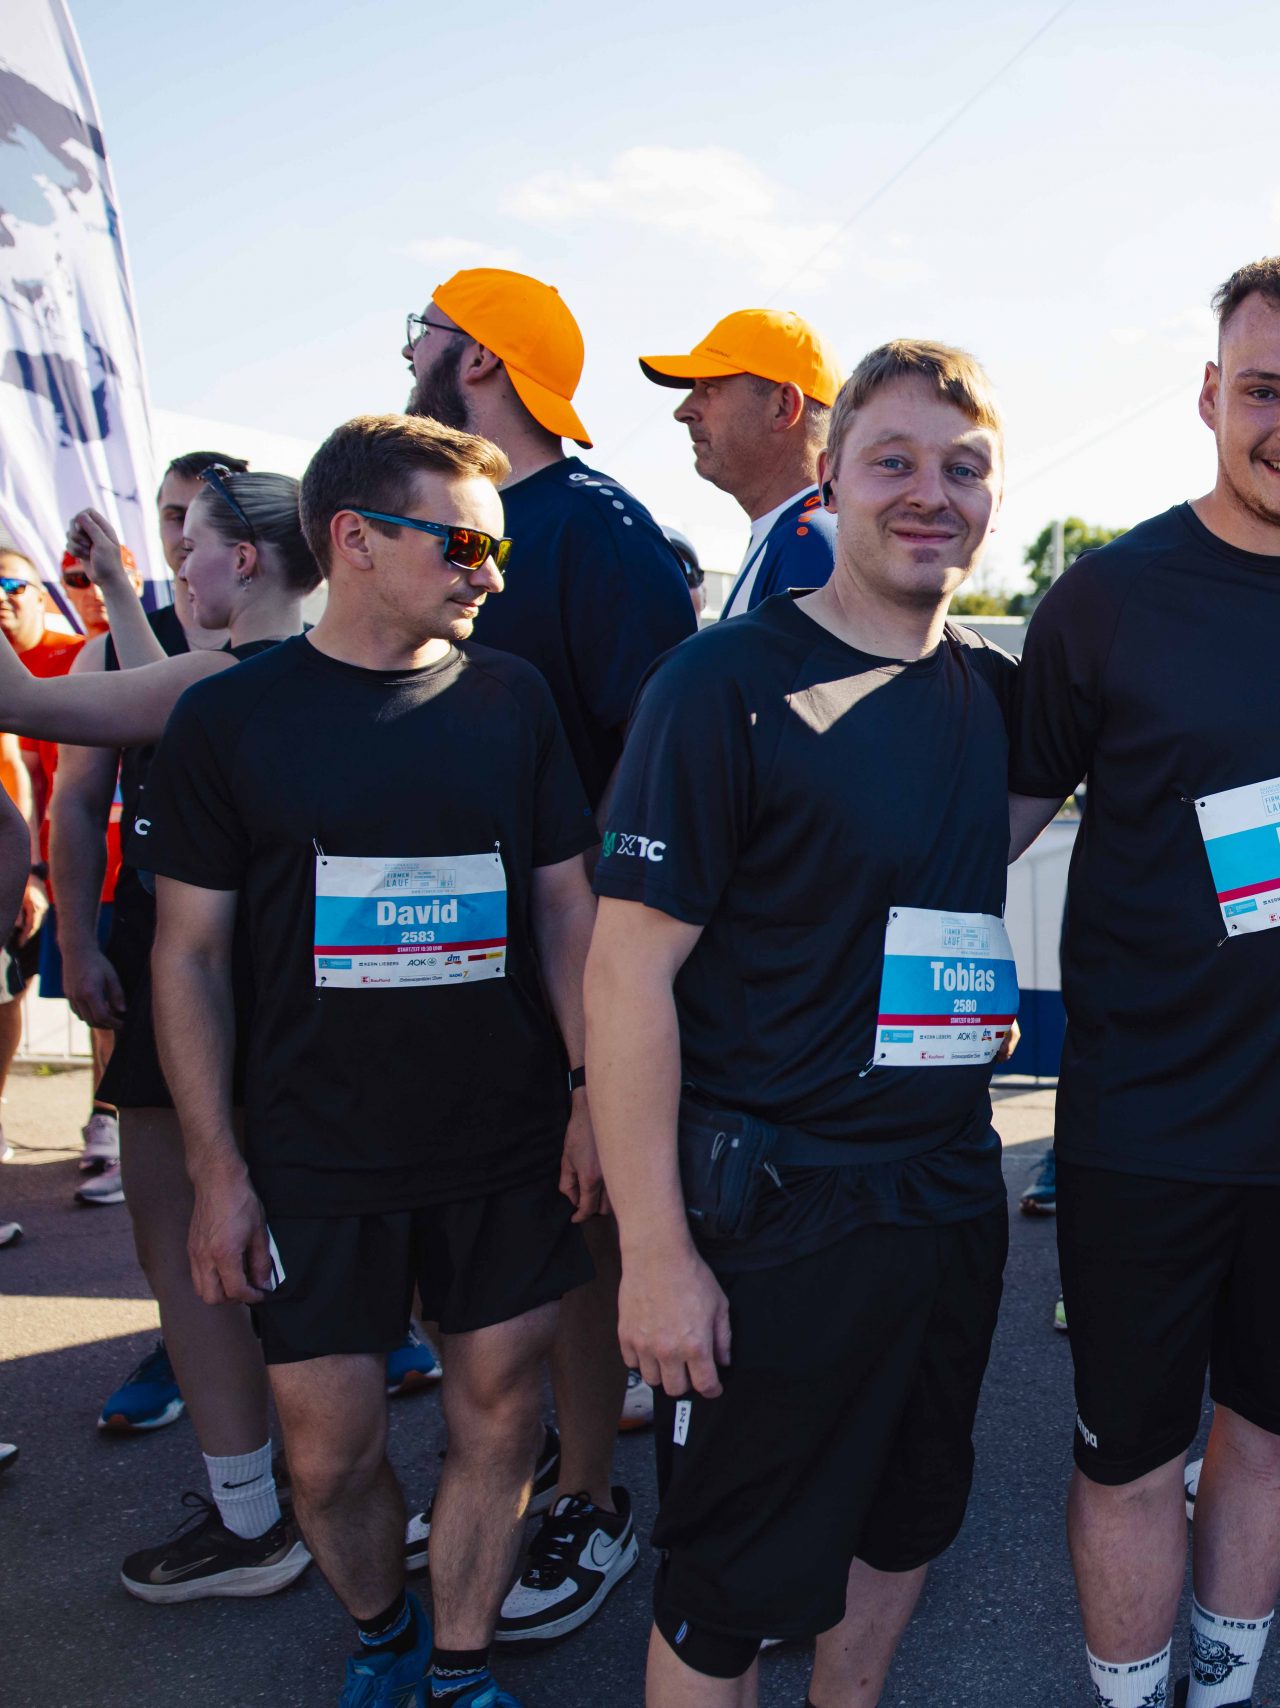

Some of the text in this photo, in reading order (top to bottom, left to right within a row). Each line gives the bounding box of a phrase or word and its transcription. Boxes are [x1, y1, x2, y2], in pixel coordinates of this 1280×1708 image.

[386, 879, 409, 888] LAUF
[377, 899, 458, 926] David
[401, 930, 435, 943] 2583
[407, 959, 427, 967] AOK
[447, 953, 460, 962] dm
[930, 961, 995, 992] Tobias
[953, 999, 977, 1013] 2580
[957, 1032, 971, 1041] AOK
